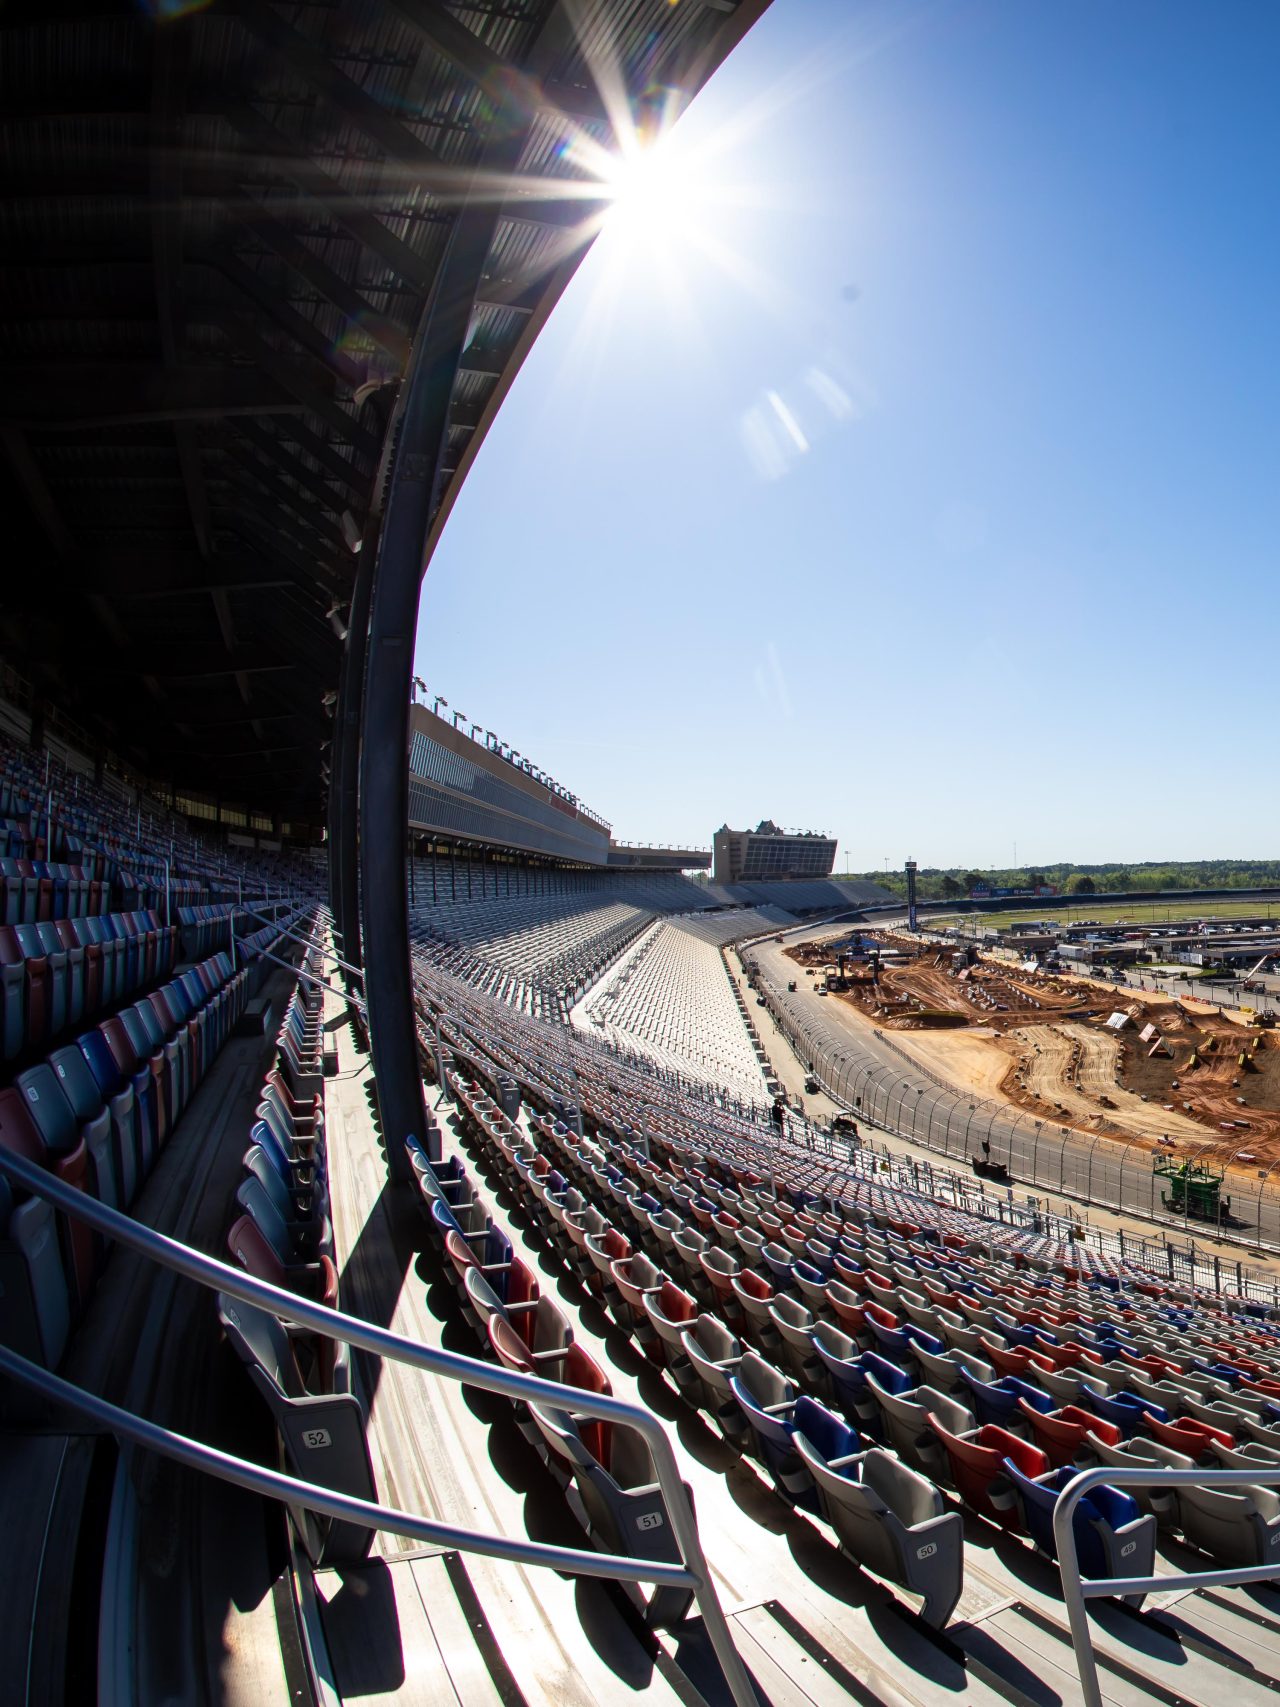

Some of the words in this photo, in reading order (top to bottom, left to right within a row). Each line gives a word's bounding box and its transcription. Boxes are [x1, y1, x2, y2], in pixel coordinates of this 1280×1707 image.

[308, 1431, 327, 1446] 52
[642, 1514, 658, 1528] 51
[920, 1545, 934, 1557] 50
[1124, 1543, 1134, 1554] 49
